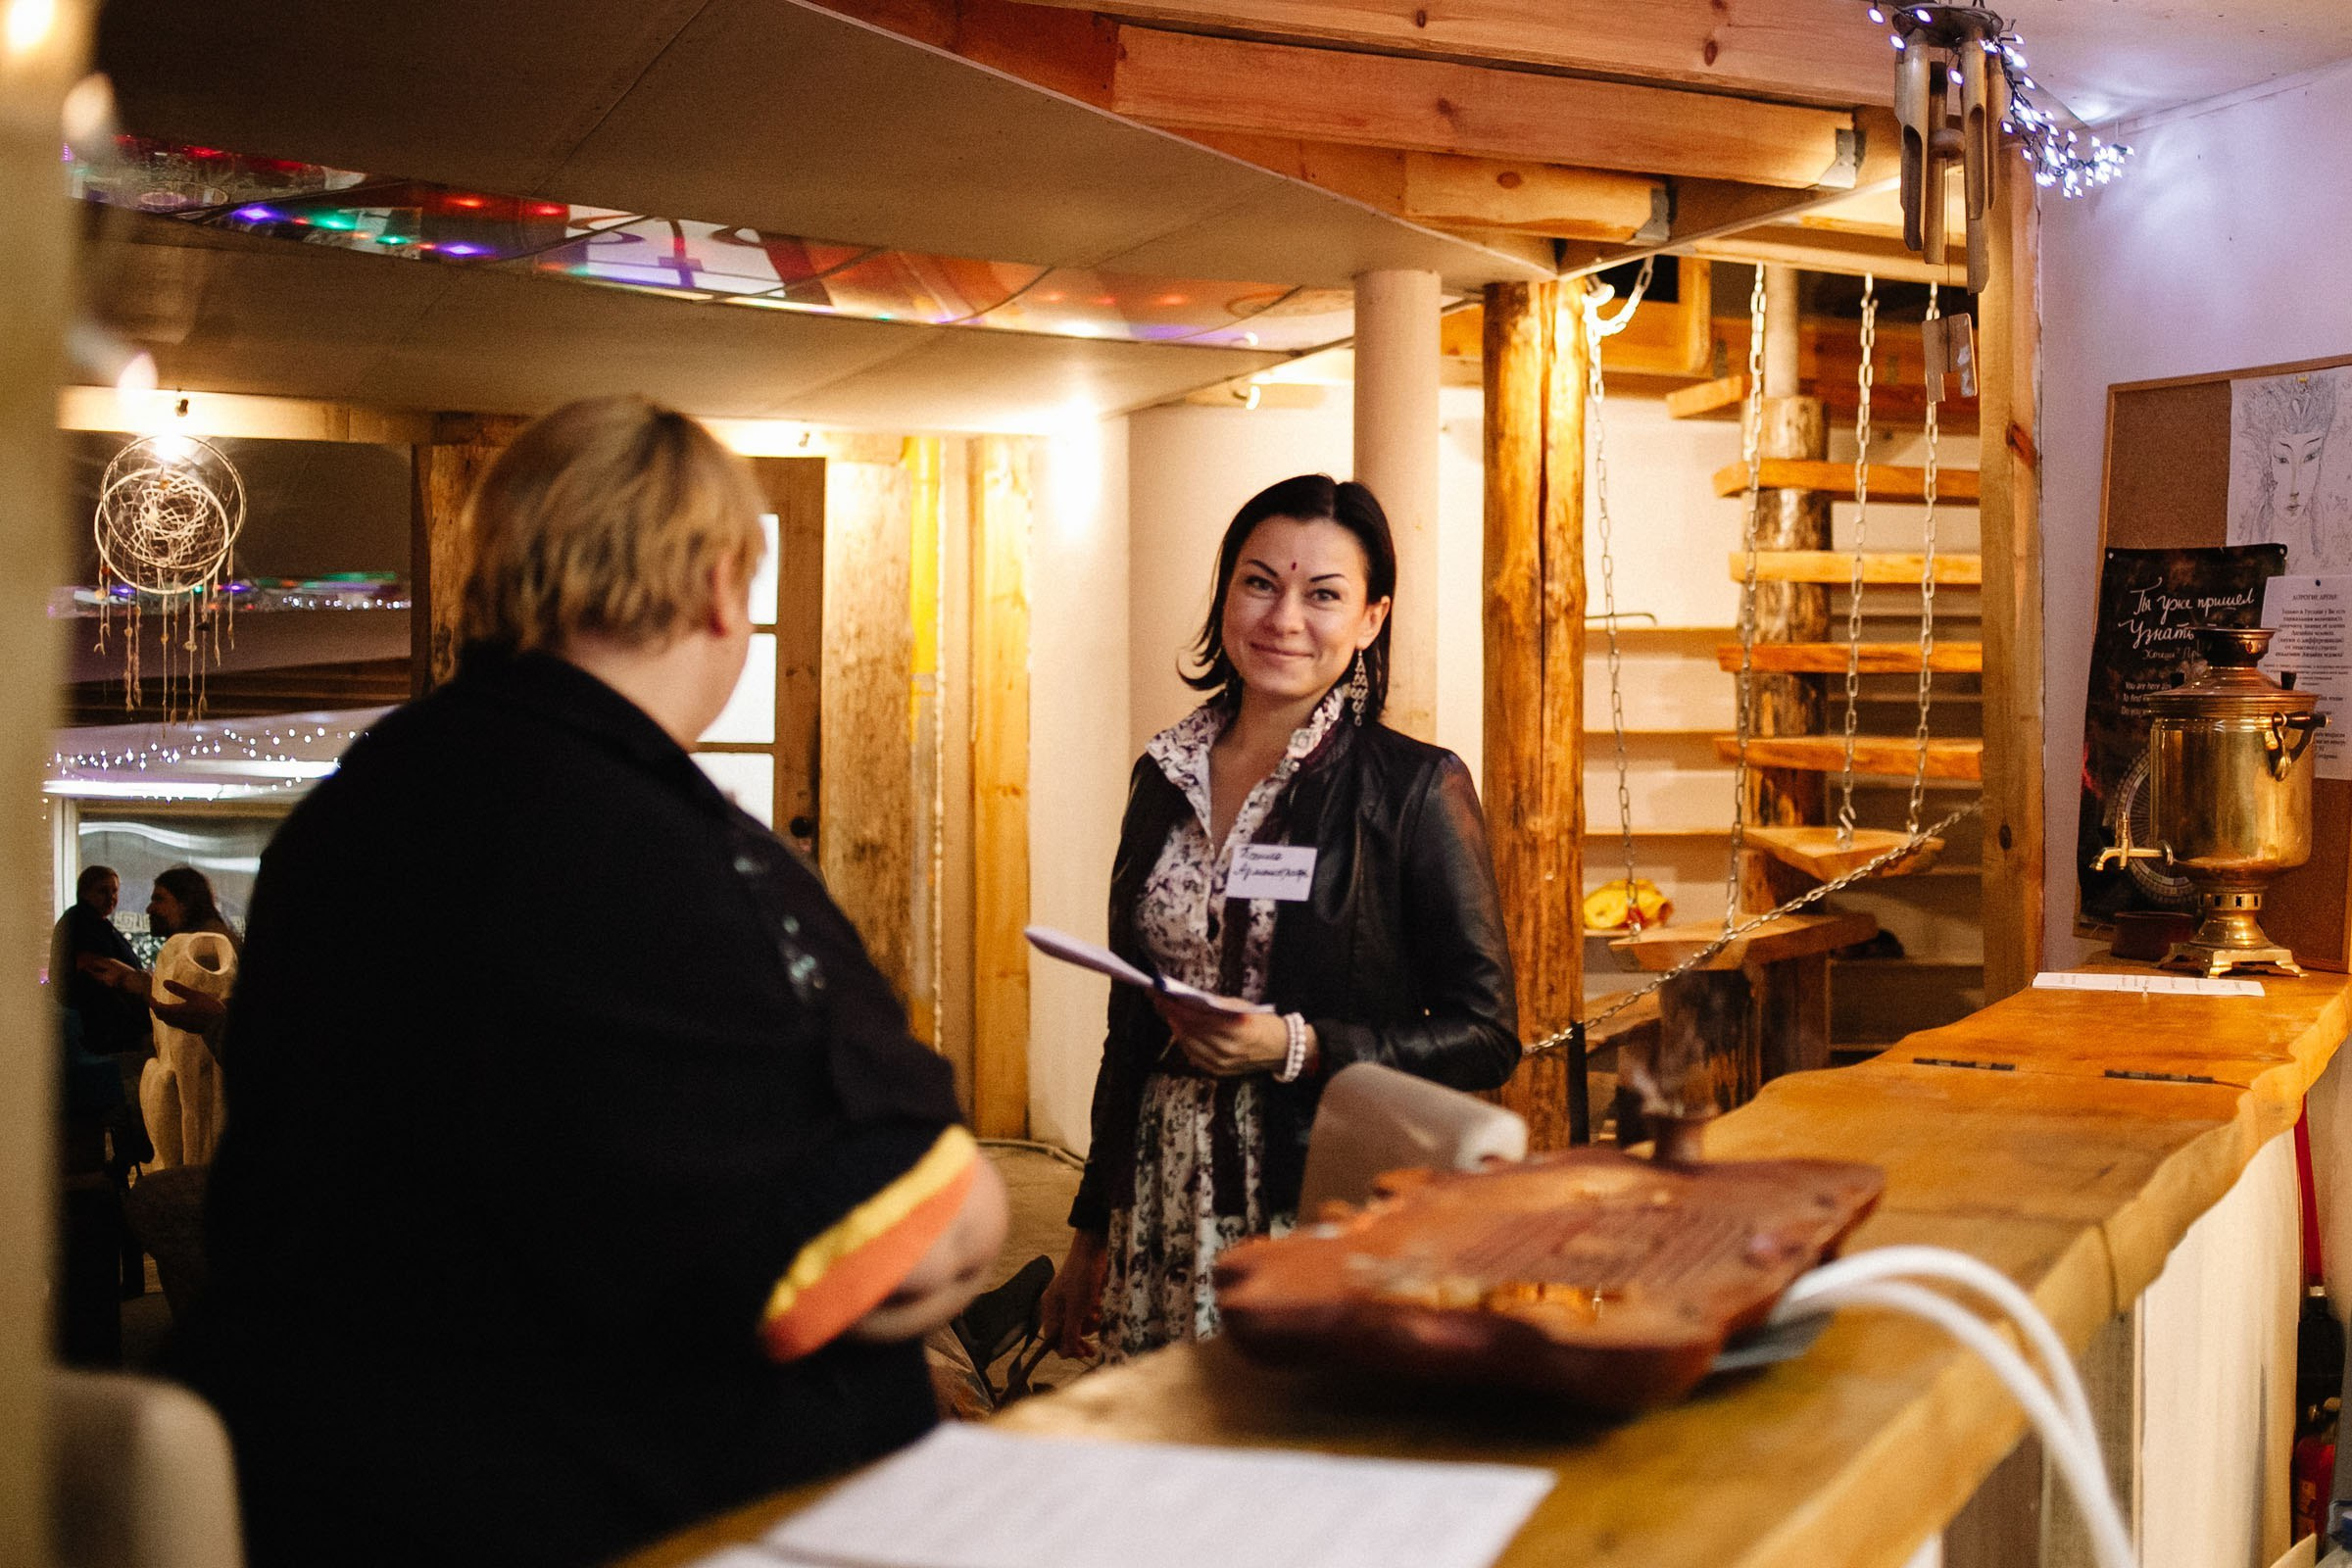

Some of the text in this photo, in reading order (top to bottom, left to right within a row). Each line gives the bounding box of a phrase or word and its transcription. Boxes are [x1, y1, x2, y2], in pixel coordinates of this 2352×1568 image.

[2130, 576, 2162, 615] Ты
[2197, 587, 2254, 617] пришел
[2118, 619, 2194, 649] Узнать
